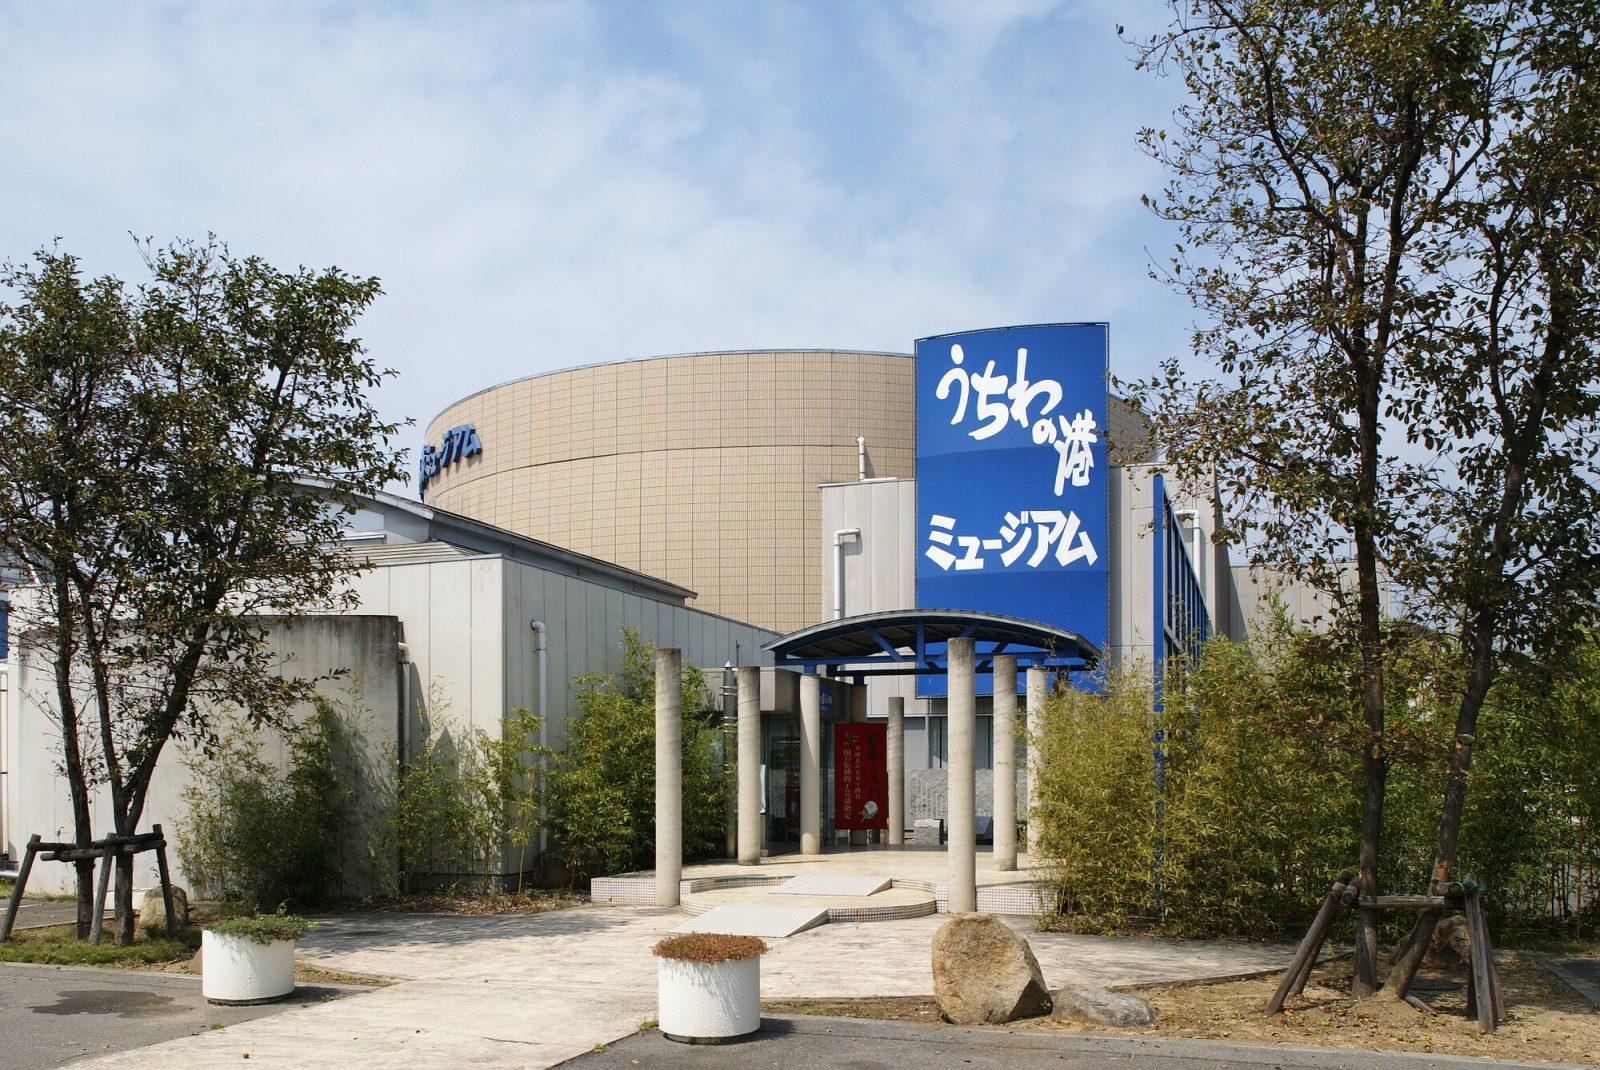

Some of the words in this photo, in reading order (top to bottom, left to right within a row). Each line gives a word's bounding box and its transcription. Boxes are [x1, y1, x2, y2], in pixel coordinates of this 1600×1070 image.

[936, 344, 1097, 496] うちわの港
[925, 511, 1098, 571] ミュージアム
